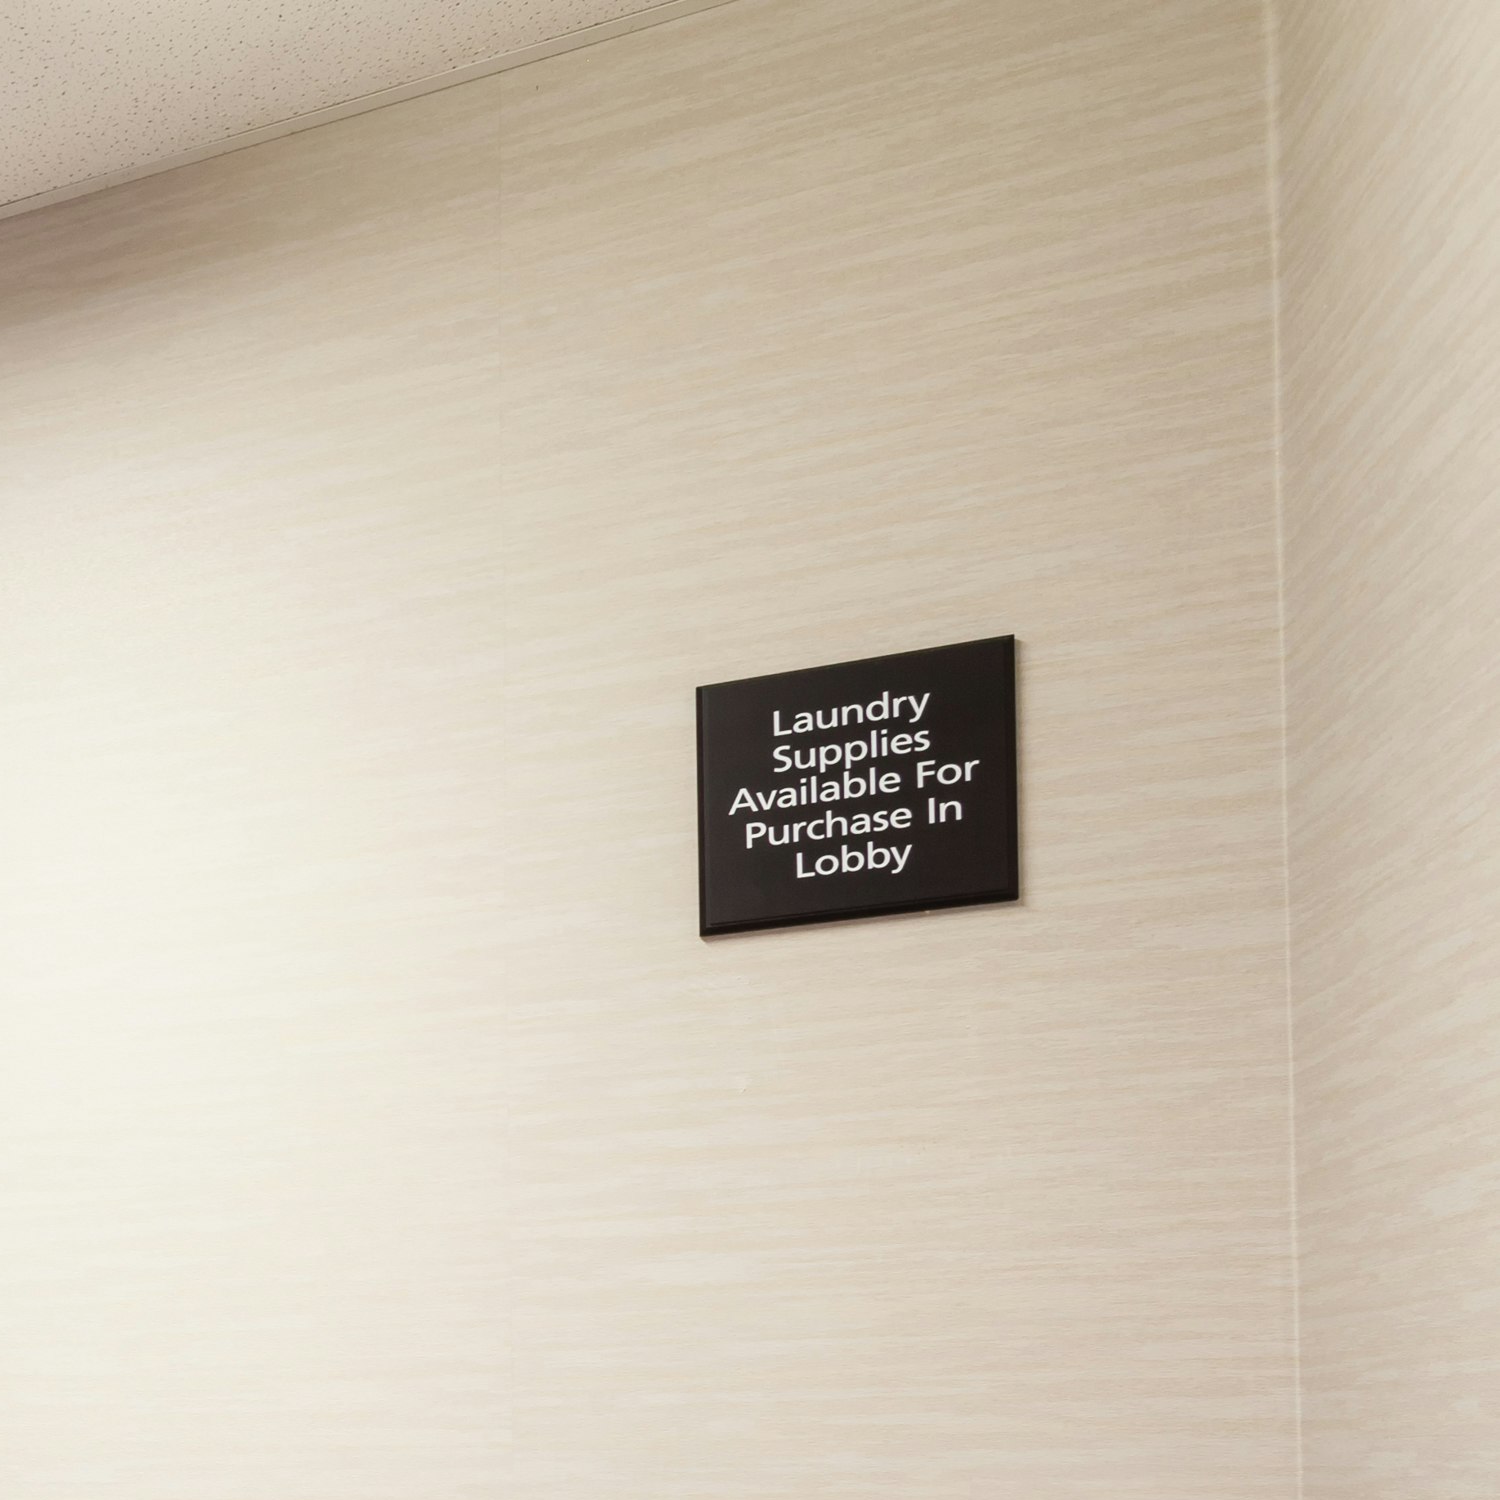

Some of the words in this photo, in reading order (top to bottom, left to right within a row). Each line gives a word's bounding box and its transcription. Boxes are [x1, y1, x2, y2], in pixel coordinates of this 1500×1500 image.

[773, 691, 930, 737] Laundry
[772, 729, 930, 773] Supplies
[728, 767, 901, 815] Available
[917, 759, 980, 788] For
[746, 807, 911, 849] Purchase
[928, 798, 962, 824] In
[796, 841, 912, 878] Lobby
